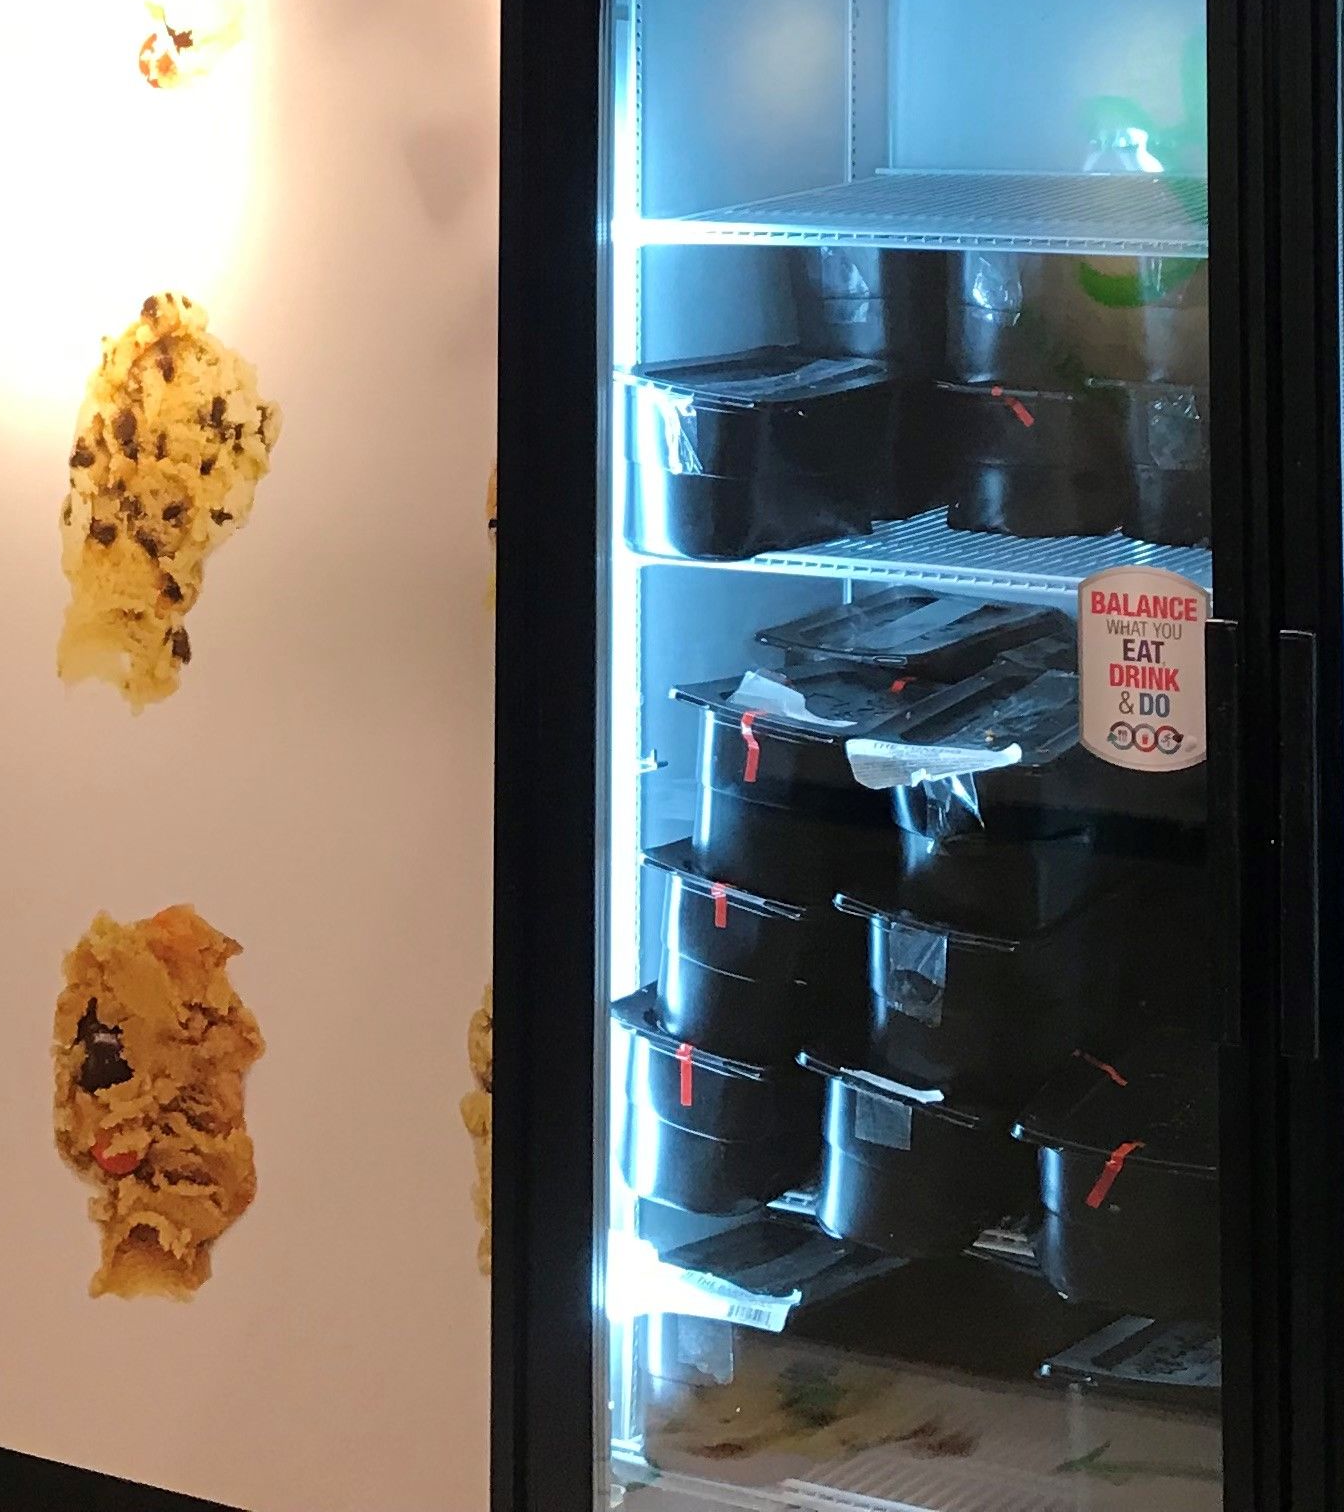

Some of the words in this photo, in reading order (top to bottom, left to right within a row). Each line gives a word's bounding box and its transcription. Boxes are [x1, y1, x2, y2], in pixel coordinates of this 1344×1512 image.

[1090, 590, 1198, 622] BALANCE
[1106, 619, 1148, 637] WHAT
[1153, 622, 1183, 640] YOU
[1109, 663, 1181, 692] DRINK
[1118, 690, 1134, 715] &
[1139, 692, 1171, 718] DO
